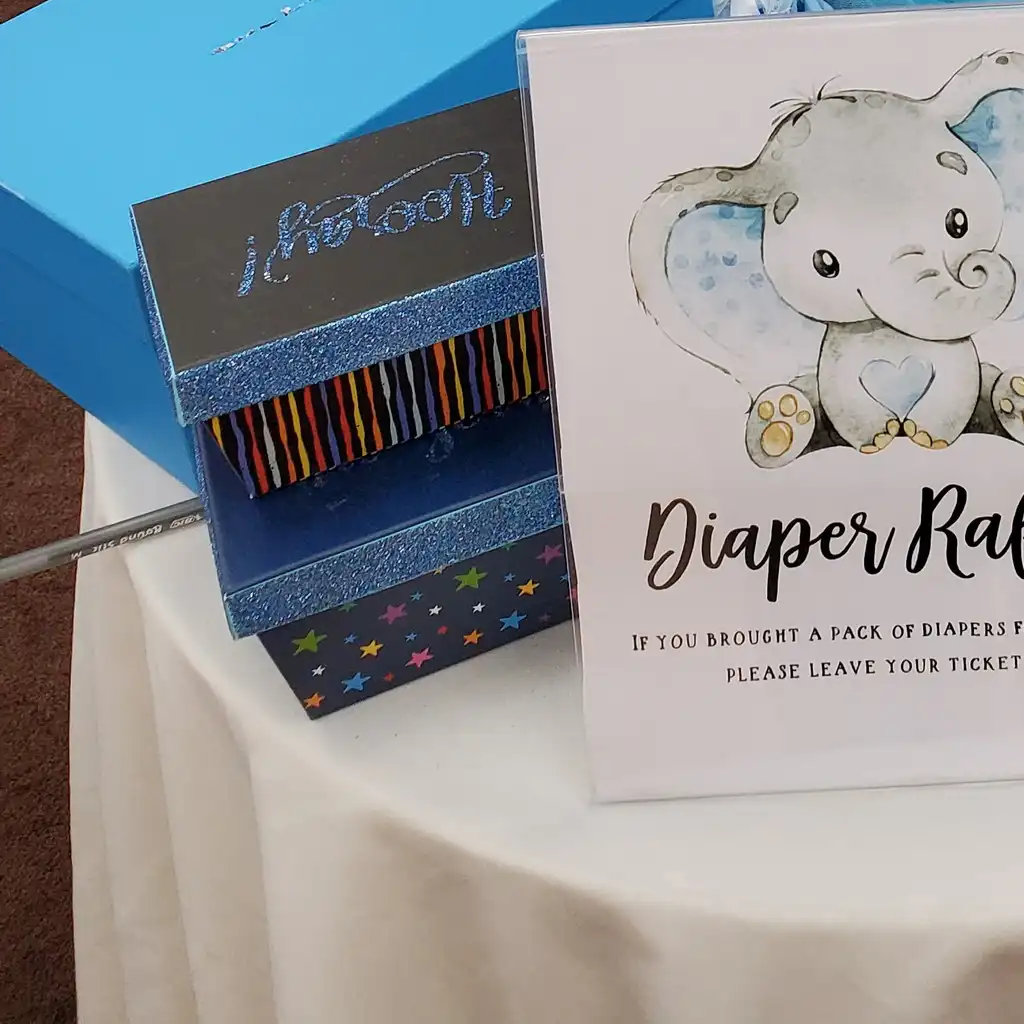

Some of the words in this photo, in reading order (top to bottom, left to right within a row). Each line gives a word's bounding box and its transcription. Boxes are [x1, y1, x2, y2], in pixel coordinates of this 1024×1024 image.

[236, 151, 513, 298] Hooray!
[91, 540, 115, 553] Stic
[119, 524, 163, 544] Round
[70, 551, 83, 559] M
[644, 499, 895, 602] Diaper
[632, 633, 649, 652] IF
[656, 632, 697, 651] YOU
[706, 627, 799, 648] BROUGHT
[809, 627, 822, 642] A
[831, 624, 883, 642] PACK
[892, 623, 915, 640] OF
[922, 619, 1006, 640] DIAPERS
[726, 664, 800, 684] PLEASE
[809, 659, 876, 678] LEAVE
[885, 656, 939, 676] YOUR
[948, 654, 1022, 673] TICKET
